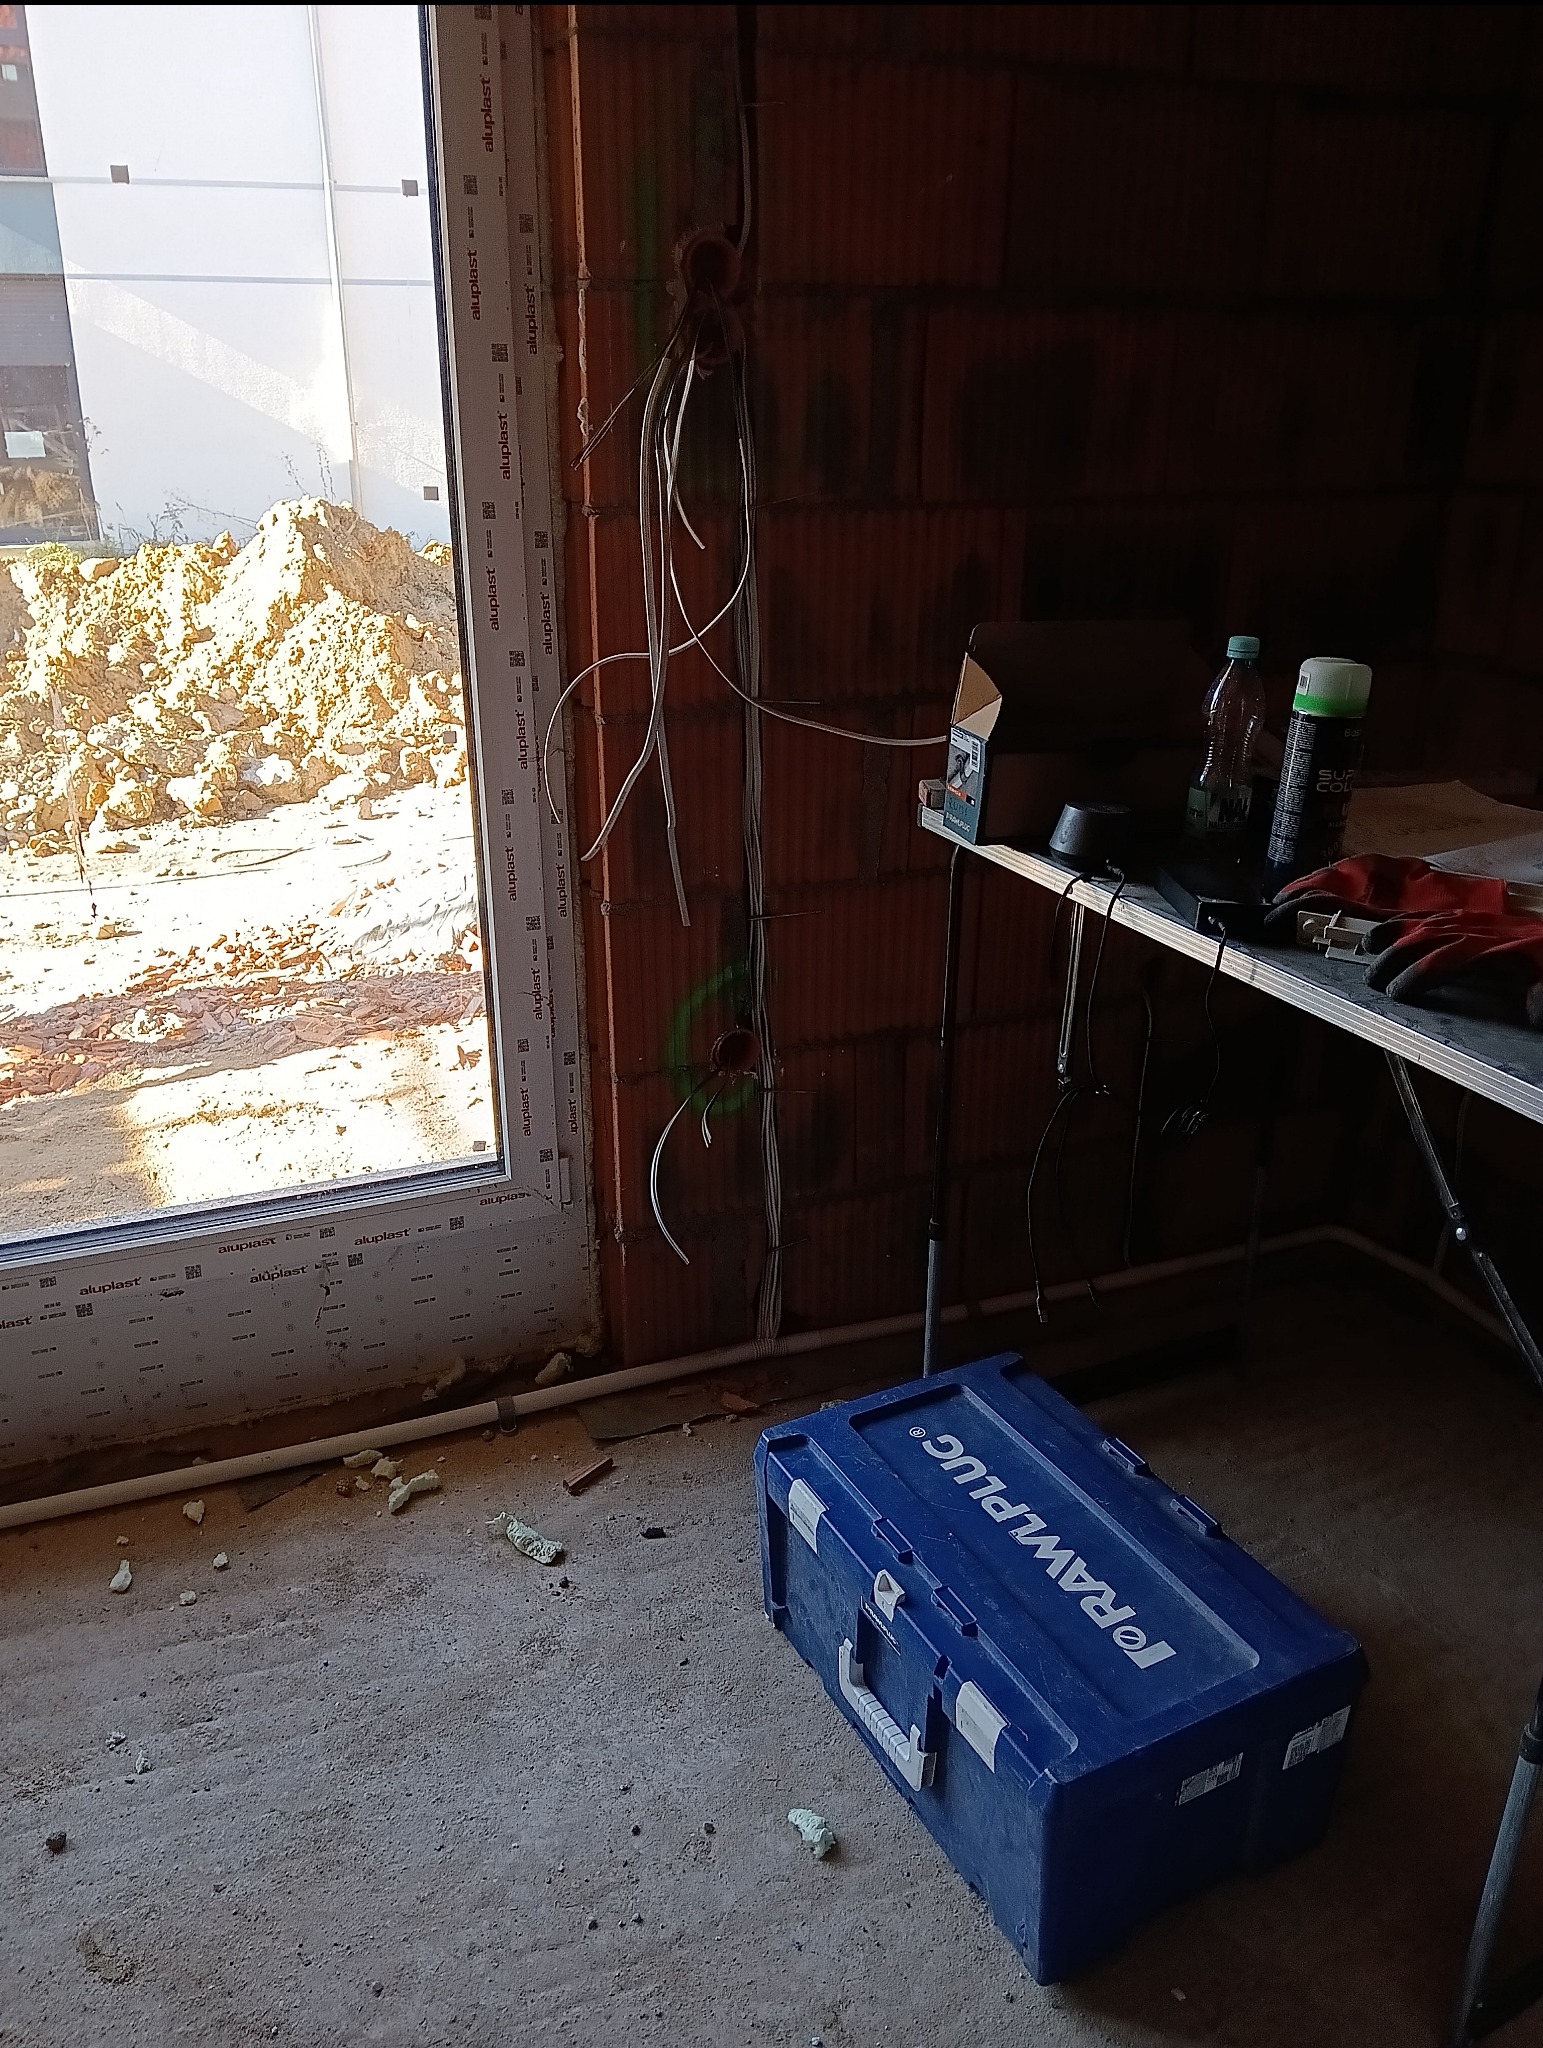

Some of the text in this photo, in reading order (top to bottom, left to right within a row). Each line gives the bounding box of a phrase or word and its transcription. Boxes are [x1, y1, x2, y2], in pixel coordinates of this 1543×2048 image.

[480, 77, 495, 152] aluplast
[467, 247, 481, 320] aluplast
[524, 283, 538, 354] aluplast
[497, 411, 511, 479] aluplast
[486, 566, 500, 631] aluplast
[540, 592, 553, 654] aluplast
[516, 711, 529, 770] aluplast
[505, 846, 517, 901] aluplast
[556, 864, 567, 917] aluplast
[530, 968, 543, 1020] aluplast
[520, 1088, 532, 1136] aluplast
[217, 1237, 277, 1254] aluplast
[355, 1228, 411, 1247] aluplast
[79, 1277, 141, 1297] aluplast
[250, 1265, 308, 1283] aluplast
